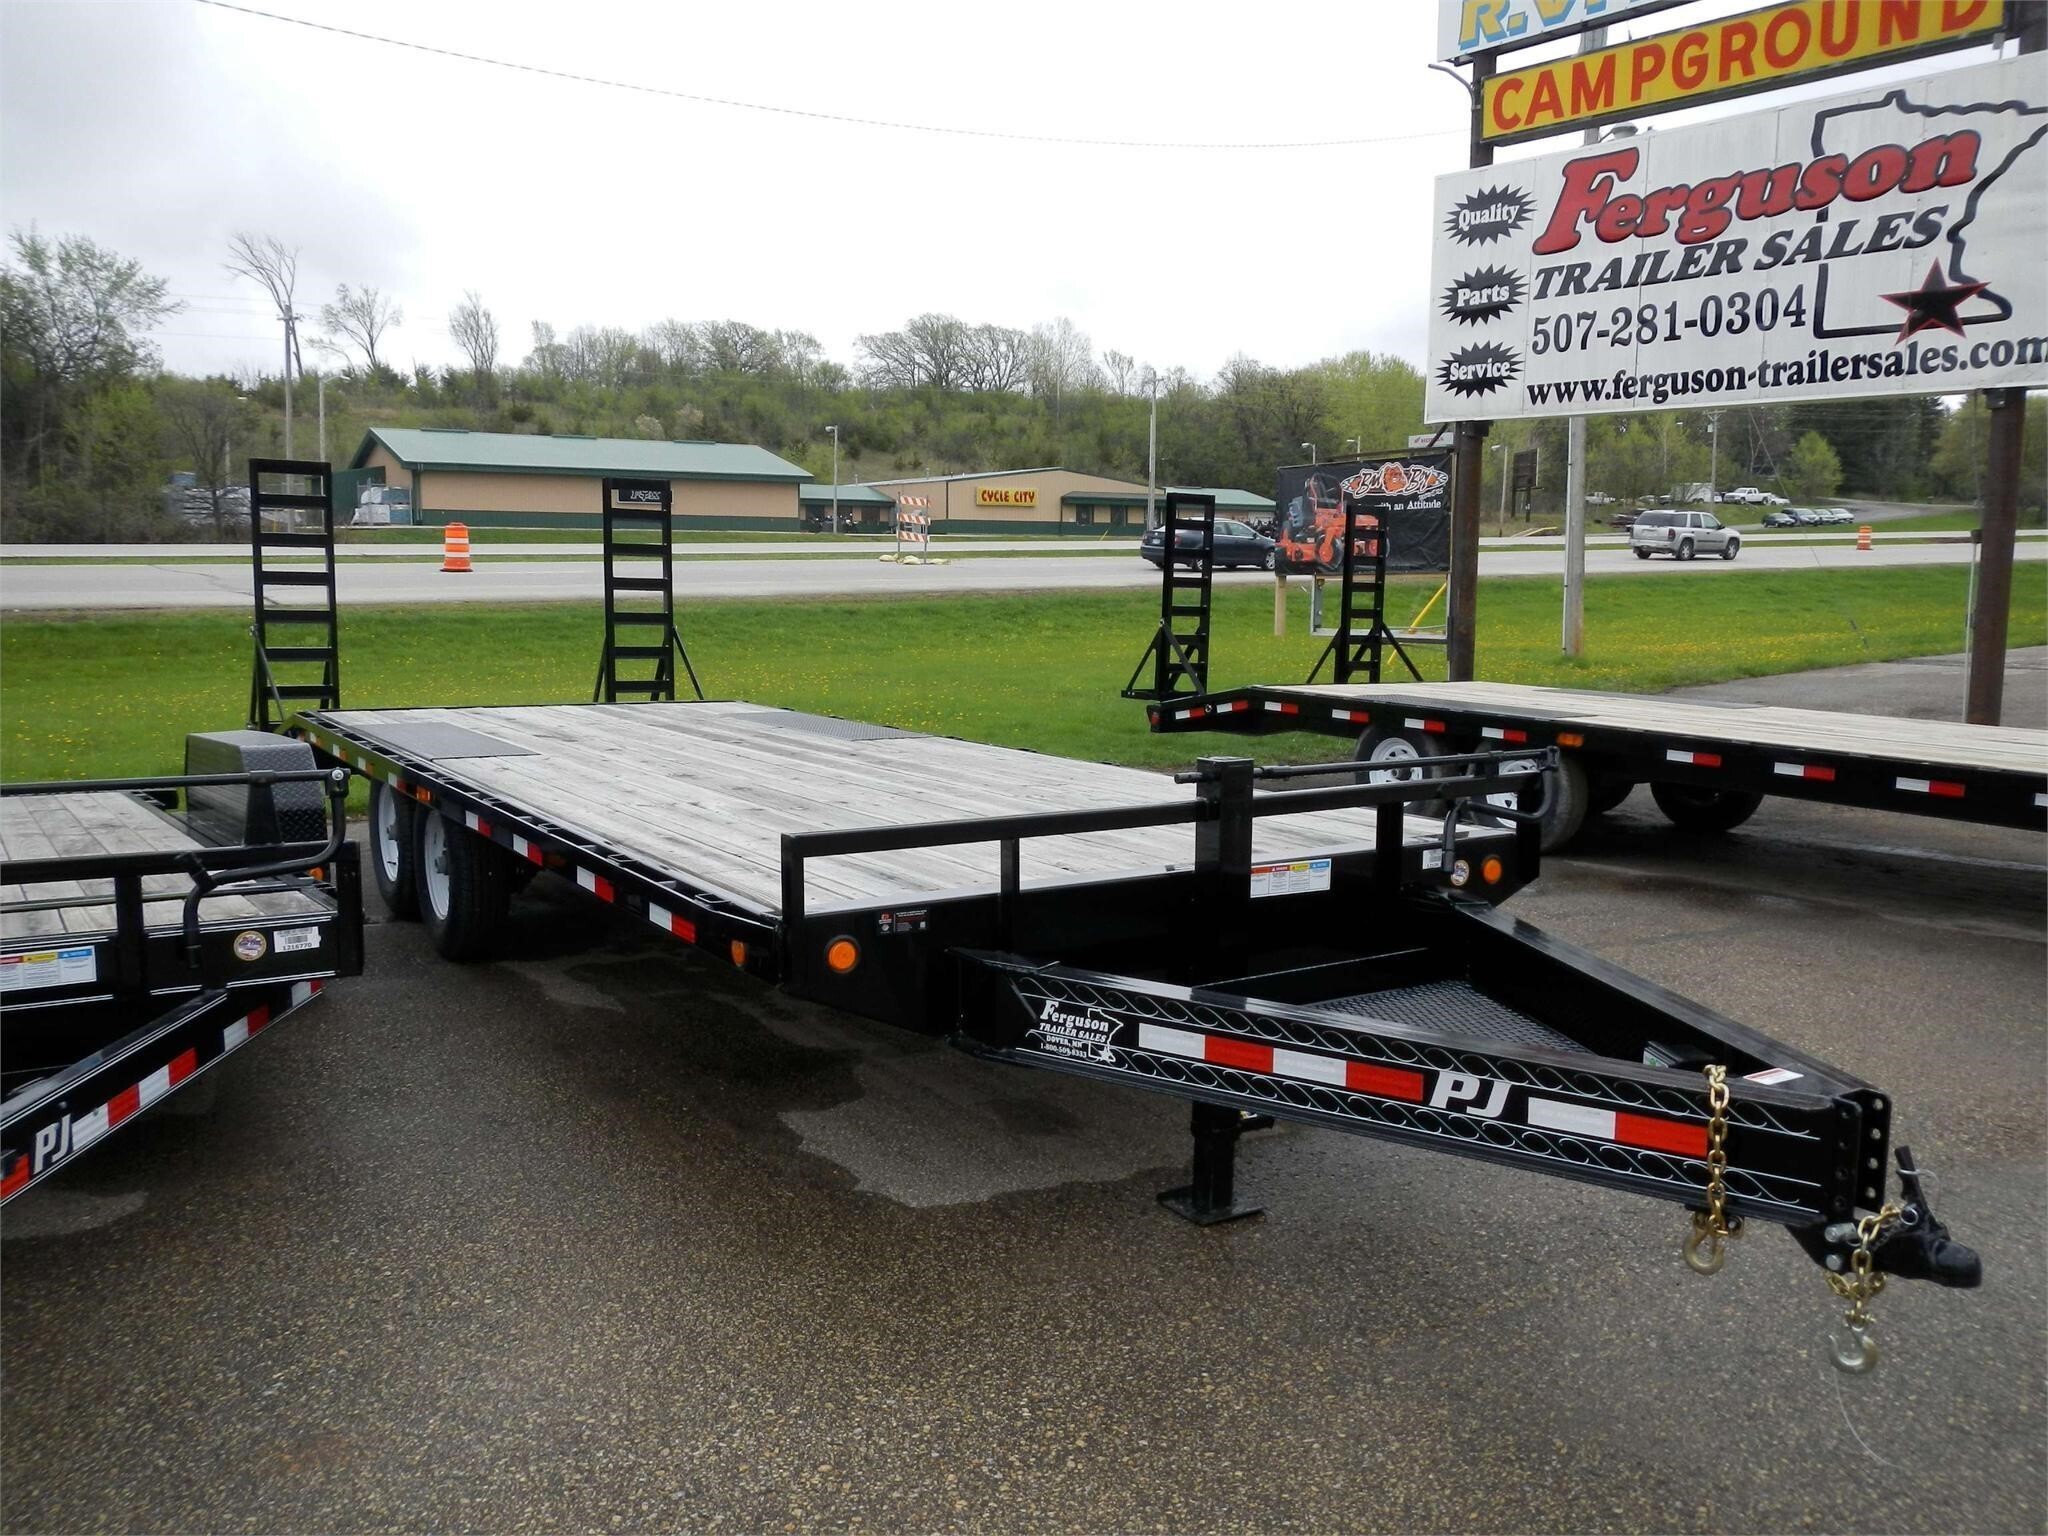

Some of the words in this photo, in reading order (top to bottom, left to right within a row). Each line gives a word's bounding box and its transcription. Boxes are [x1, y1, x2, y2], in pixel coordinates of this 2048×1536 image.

[1492, 0, 1989, 130] CAMPGROUND
[1531, 129, 1981, 255] Ferguson
[1458, 202, 1520, 231] Quality
[1533, 238, 1748, 300] TRAILER
[1753, 204, 1949, 271] SALES
[1456, 284, 1510, 308] Parts
[1531, 284, 1806, 355] 507-281-0304
[1449, 357, 1511, 382] Service
[1527, 336, 2048, 405] www.ferguson-trailersales.com
[981, 489, 1010, 503] CYCLE
[1014, 490, 1035, 503] CITY
[1393, 502, 1404, 511] an
[1407, 500, 1442, 510] Attitude
[1040, 999, 1109, 1032] Ferguson
[1040, 1023, 1076, 1036] TRAILER
[1078, 1031, 1107, 1042] SALES
[1429, 1070, 1513, 1118] PJ
[33, 1112, 72, 1175] PJ
